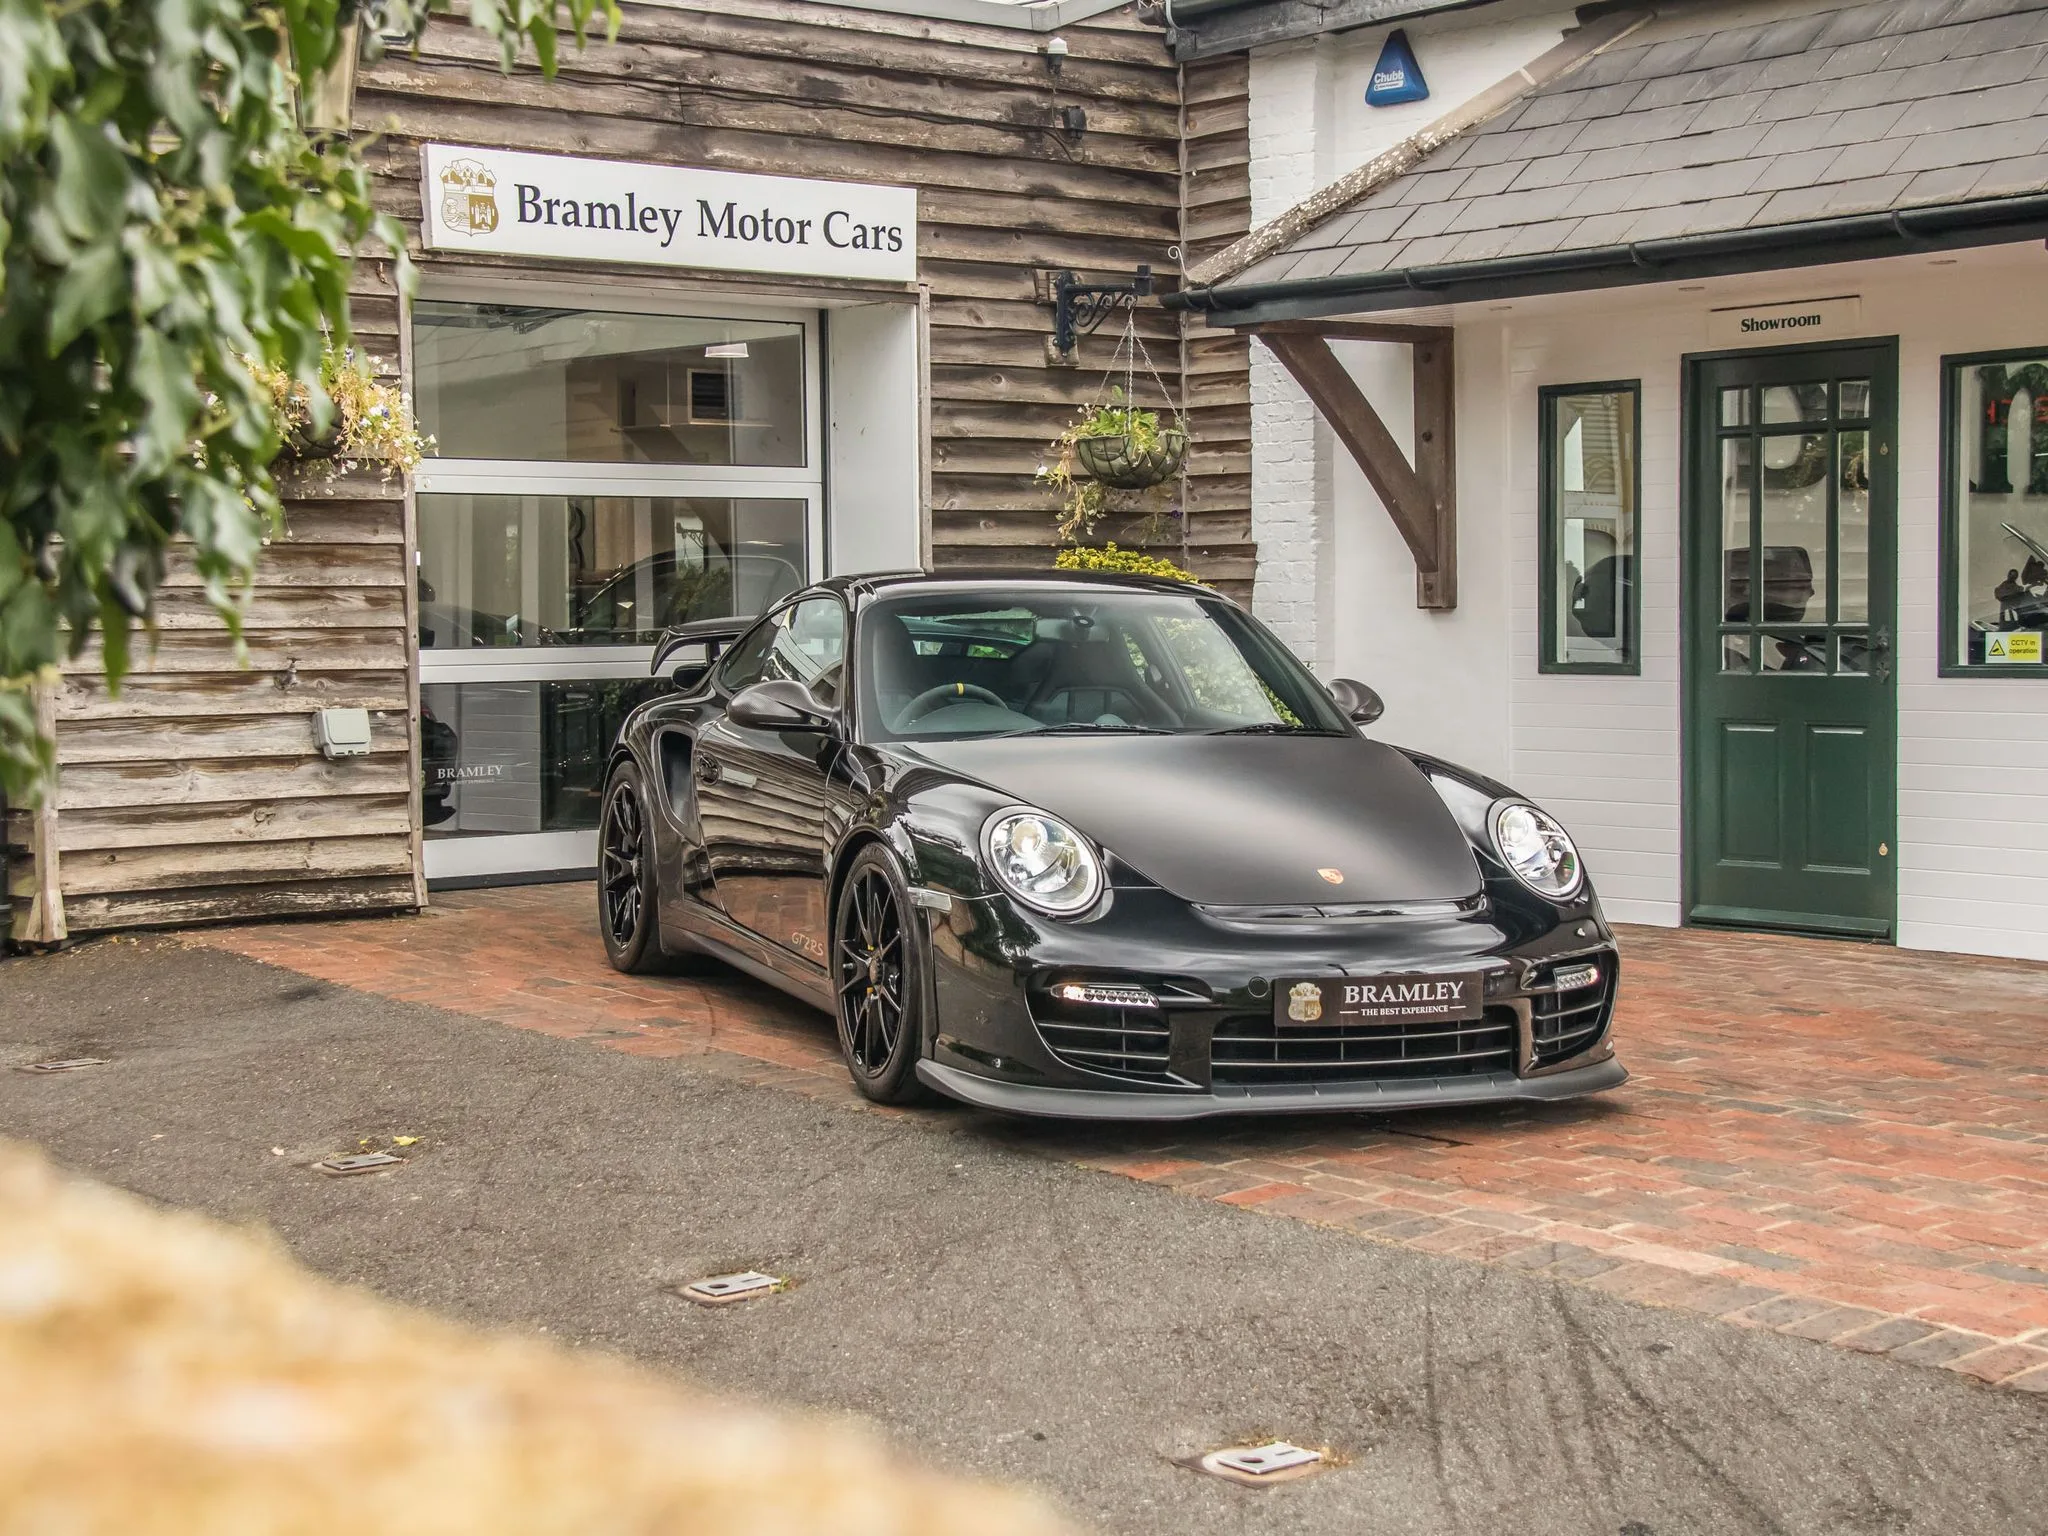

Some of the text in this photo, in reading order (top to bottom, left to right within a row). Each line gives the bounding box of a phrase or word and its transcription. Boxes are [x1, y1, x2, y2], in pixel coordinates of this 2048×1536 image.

[1374, 70, 1404, 84] Chubb
[514, 183, 903, 252] Bramley Motor Cars
[1740, 314, 1821, 332] Showroom
[437, 765, 503, 779] BRAMLEY
[1343, 981, 1464, 1004] BRAMLEY
[1361, 1004, 1449, 1016] THE BEST EXPERIENCE
